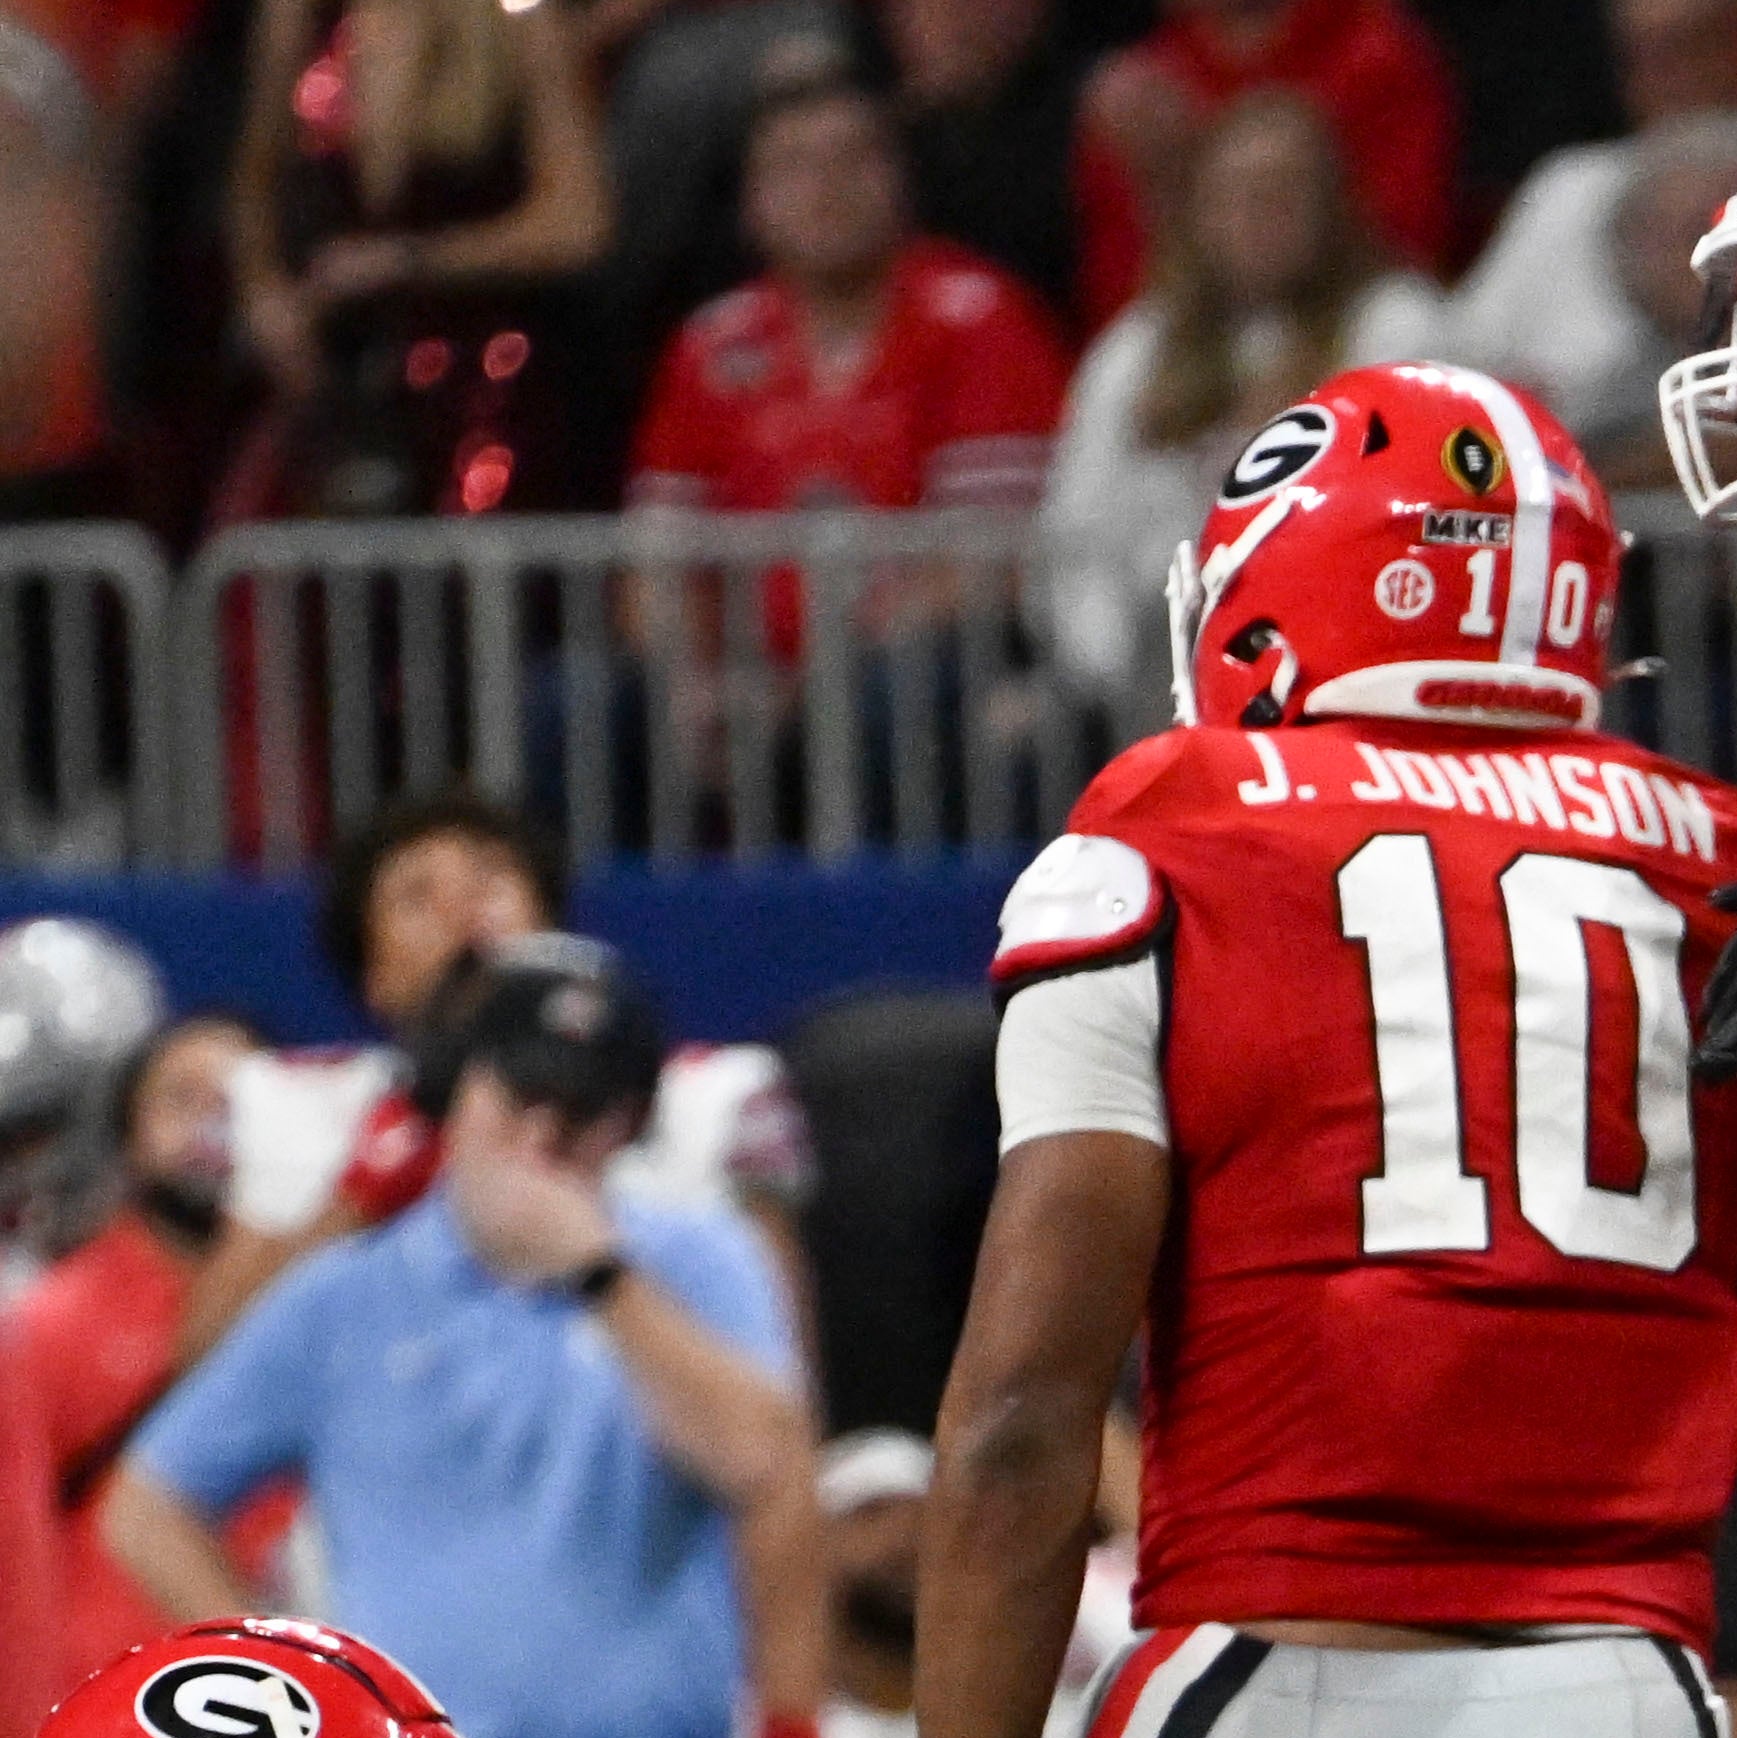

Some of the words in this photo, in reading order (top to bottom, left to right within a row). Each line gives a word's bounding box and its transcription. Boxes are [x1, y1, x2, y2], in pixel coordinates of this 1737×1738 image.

[1219, 406, 1335, 500] G
[1237, 732, 1317, 806] J.
[1351, 742, 1718, 861] JOHNSON
[1336, 833, 1699, 1272] 10
